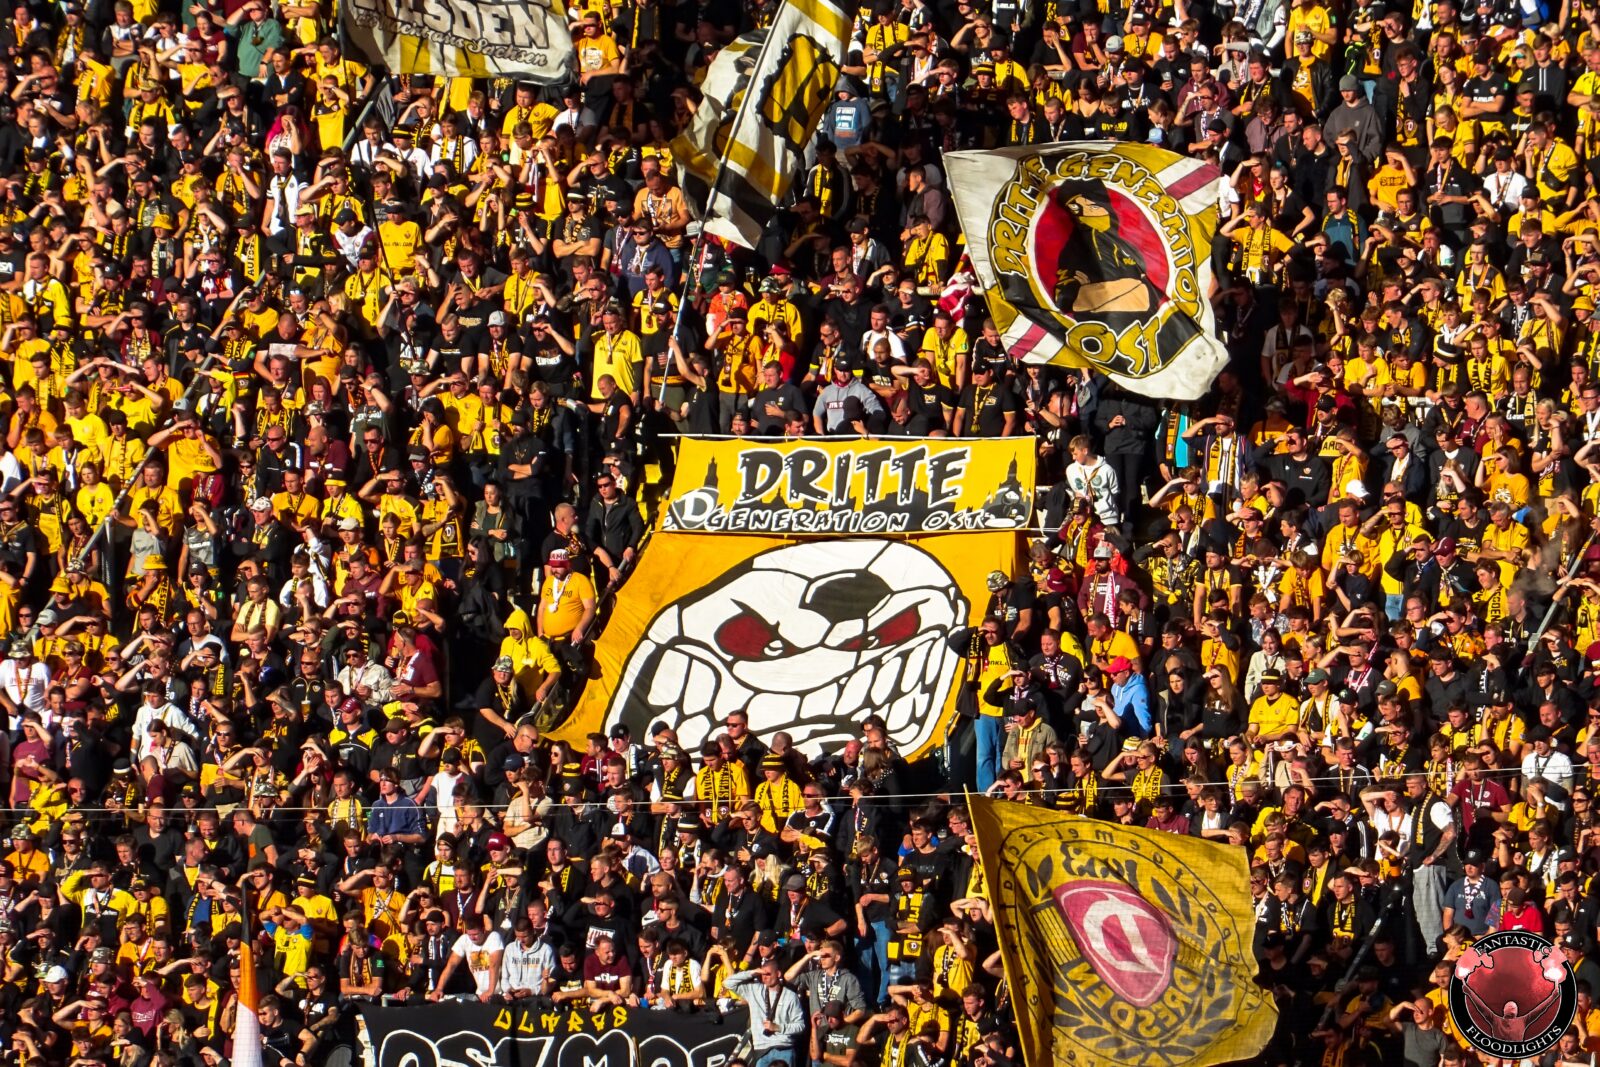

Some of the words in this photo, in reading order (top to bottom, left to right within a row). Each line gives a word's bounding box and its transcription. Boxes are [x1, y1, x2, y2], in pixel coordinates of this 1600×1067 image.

[467, 38, 549, 68] Sachsen
[991, 153, 1050, 278] DRITTE
[1056, 152, 1204, 326] GENERATIO
[1065, 317, 1161, 377] OST
[737, 444, 971, 507] DRITTE
[706, 508, 910, 533] GENERATION
[921, 508, 985, 531] OST
